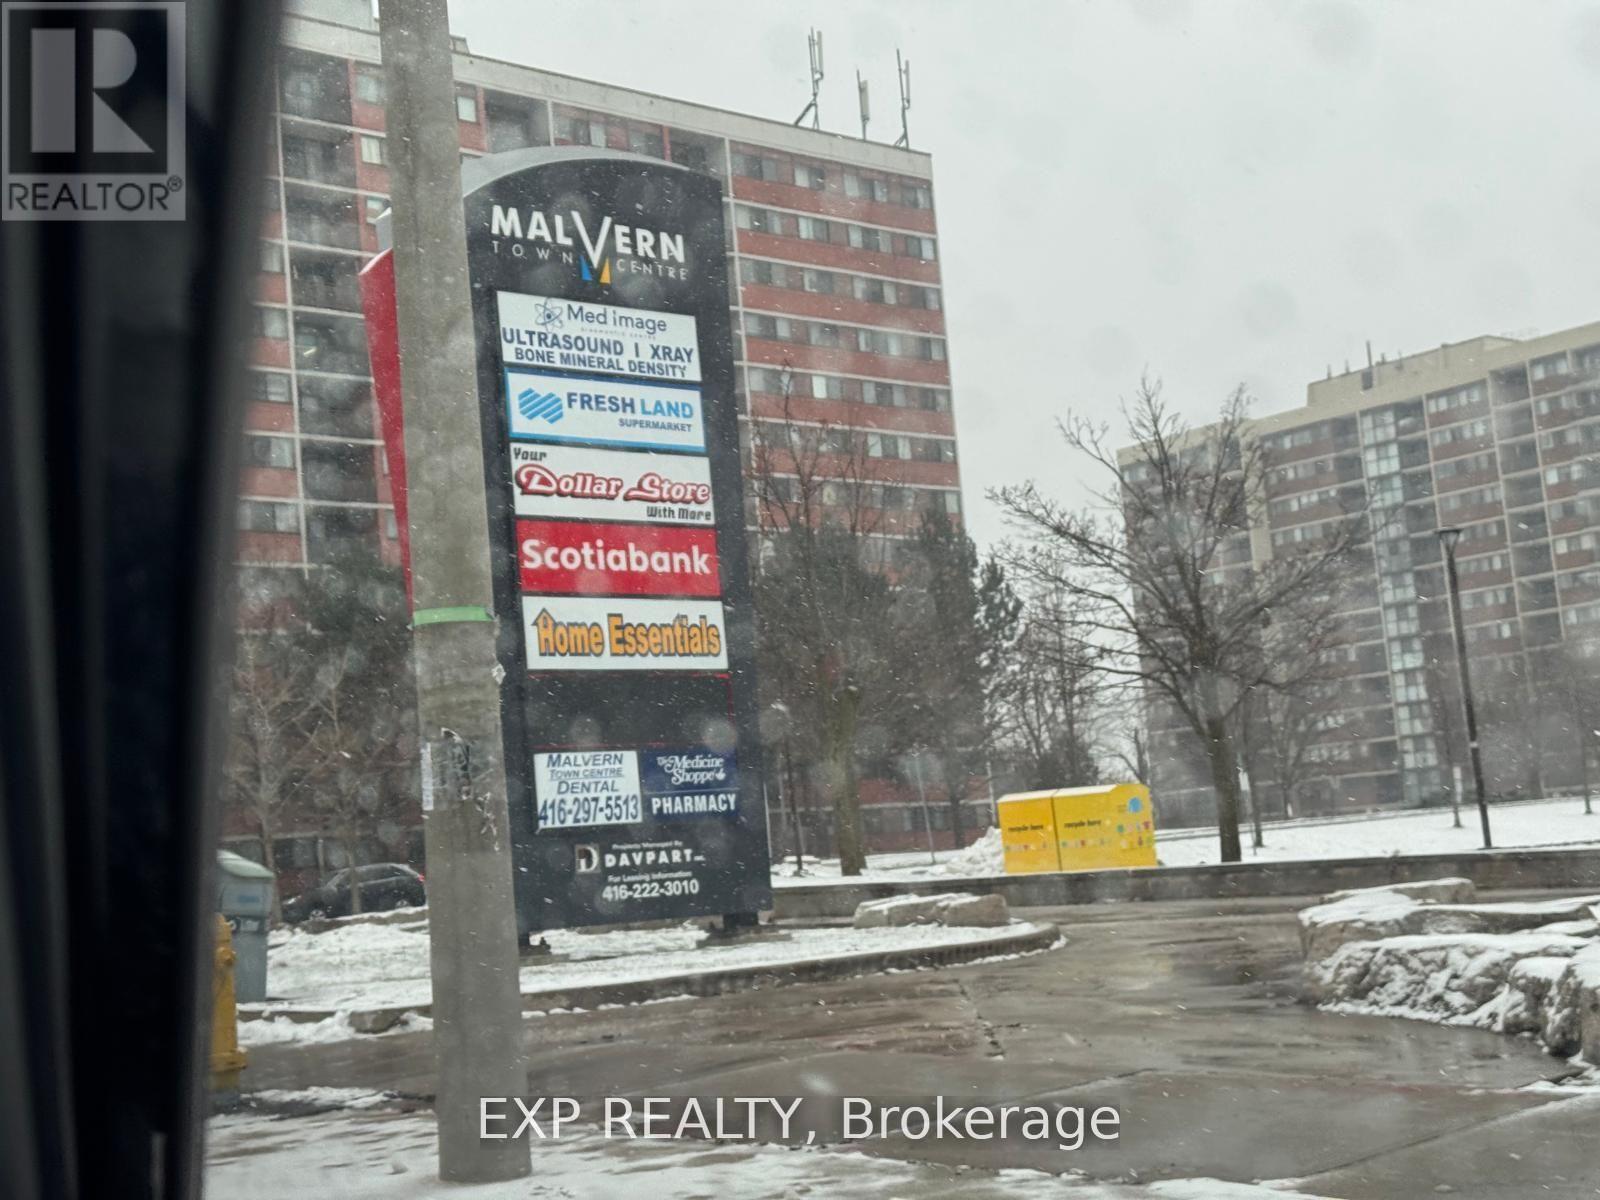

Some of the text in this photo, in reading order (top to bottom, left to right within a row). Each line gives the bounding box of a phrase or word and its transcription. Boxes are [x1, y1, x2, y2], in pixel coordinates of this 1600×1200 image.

[491, 204, 685, 269] MALVERN
[492, 240, 689, 281] TOWN CENTRE
[567, 304, 608, 326] Med
[612, 310, 667, 335] image
[502, 327, 624, 357] ULTRASOUND
[650, 344, 694, 363] XRAY
[514, 347, 687, 378] BONE MINERAL DENSITY
[567, 392, 694, 419] FRESH LAND
[618, 418, 693, 433] SUPERMARKET
[513, 447, 547, 462] Your
[515, 464, 711, 504] Dollar Store
[646, 506, 712, 521] With More
[521, 539, 711, 575] Scotiabank
[532, 607, 721, 657] Home Essentials
[547, 753, 623, 768] MALVERN
[550, 767, 624, 779] TOWN CENTRE
[664, 754, 724, 773] Medicine
[557, 780, 619, 795] DENTAL
[538, 794, 639, 826] 416-297-5513
[651, 793, 736, 815] PHARMACY
[602, 878, 700, 902] 416-222-3010
